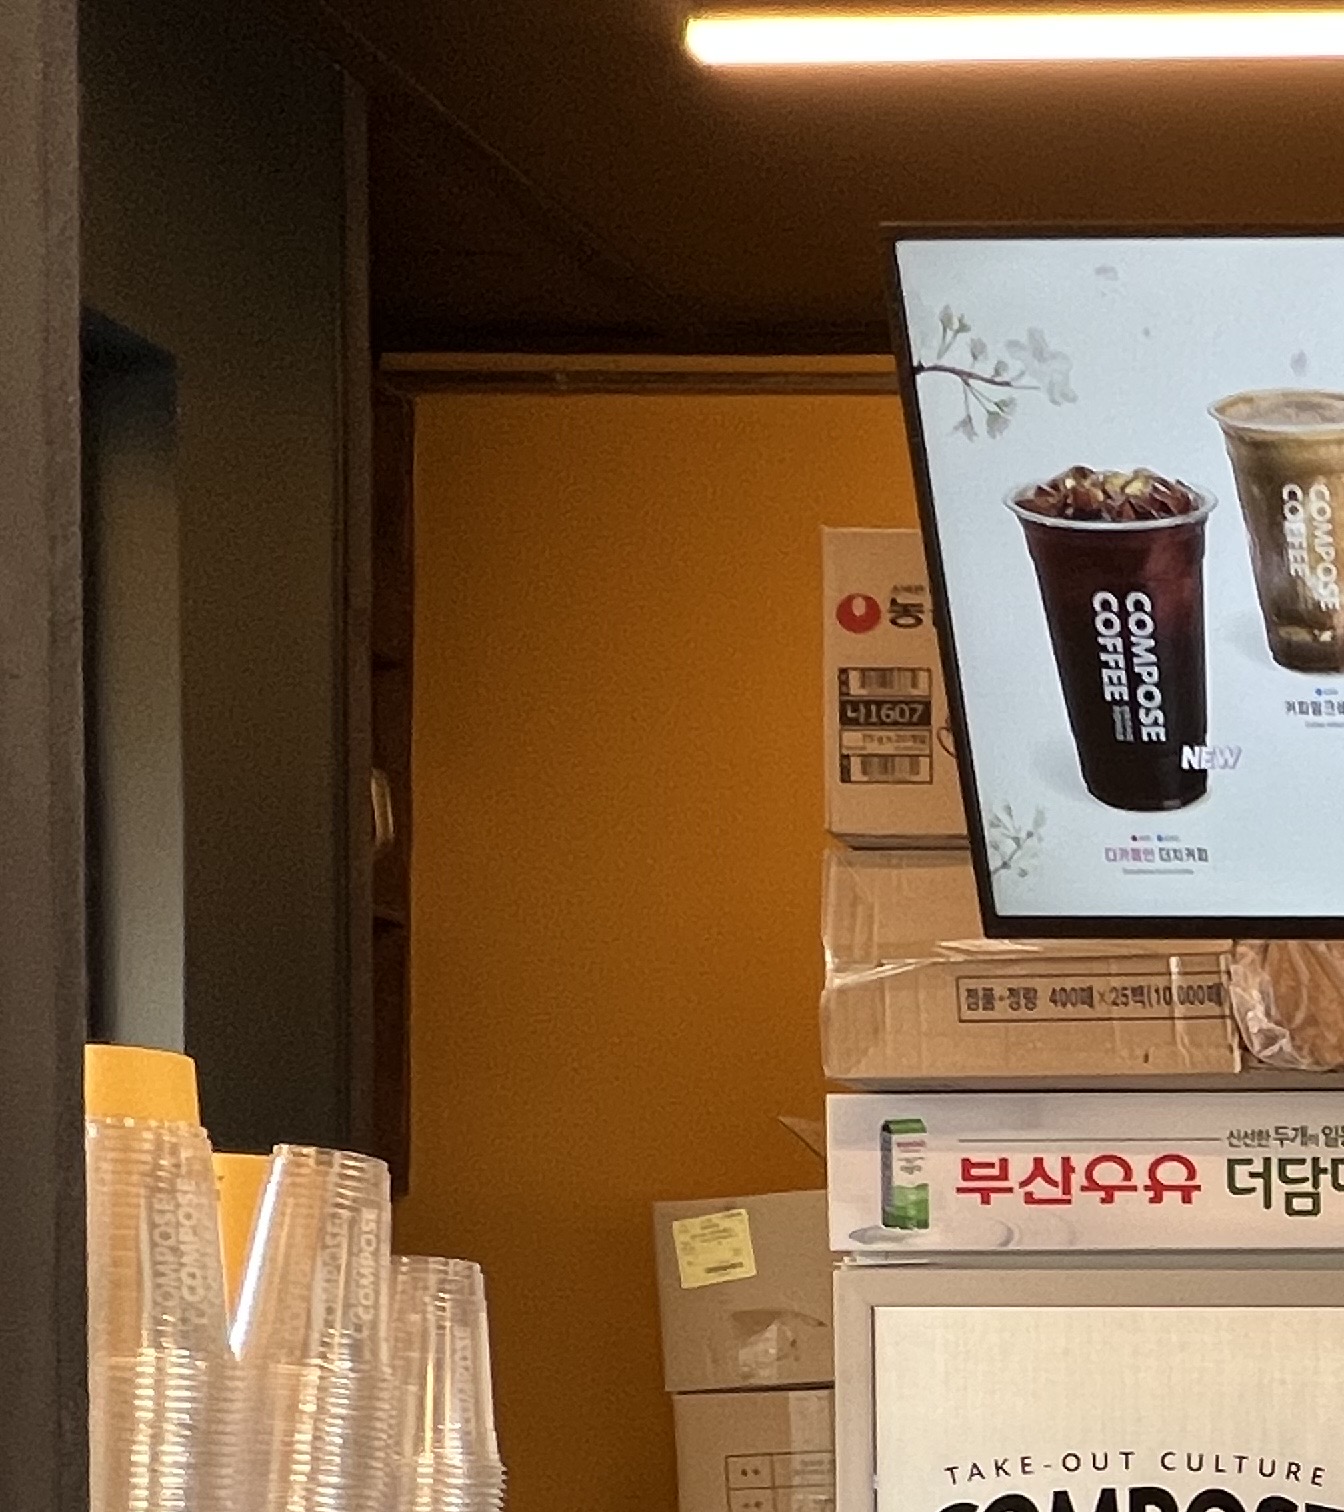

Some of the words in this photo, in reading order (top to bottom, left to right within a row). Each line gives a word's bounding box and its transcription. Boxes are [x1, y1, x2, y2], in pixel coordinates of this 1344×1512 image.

[1282, 482, 1304, 577] COFFEE
[1309, 482, 1340, 612] COMPOSE
[1092, 591, 1129, 702] COFFEE
[1125, 591, 1166, 744] COMPOSE
[1180, 745, 1242, 771] NEW
[1227, 1128, 1271, 1148] 신선한
[955, 1153, 1202, 1206] 부산우유
[945, 1451, 1136, 1486] TAKE-OUT
[1160, 1450, 1327, 1488] CULTURE
